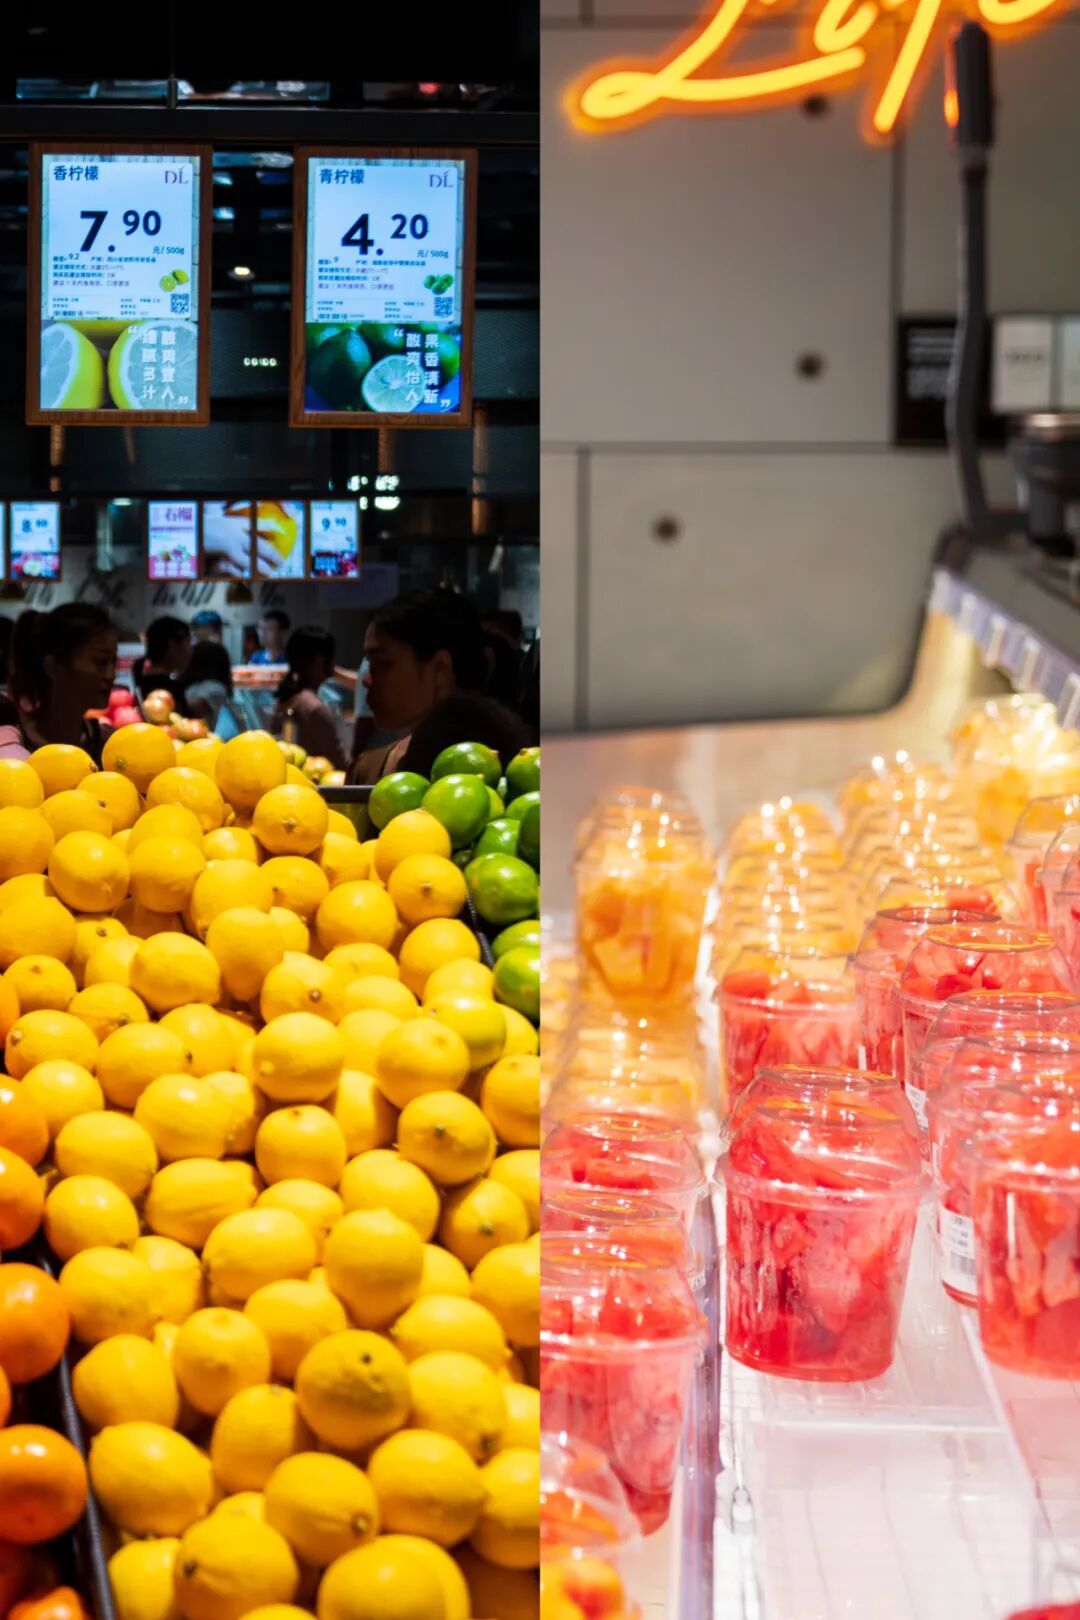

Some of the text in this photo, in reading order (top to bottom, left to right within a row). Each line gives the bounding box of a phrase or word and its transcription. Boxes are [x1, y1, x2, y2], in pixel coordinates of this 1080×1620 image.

[53, 165, 99, 181] 香柠檬
[319, 168, 365, 185] 青柠檬
